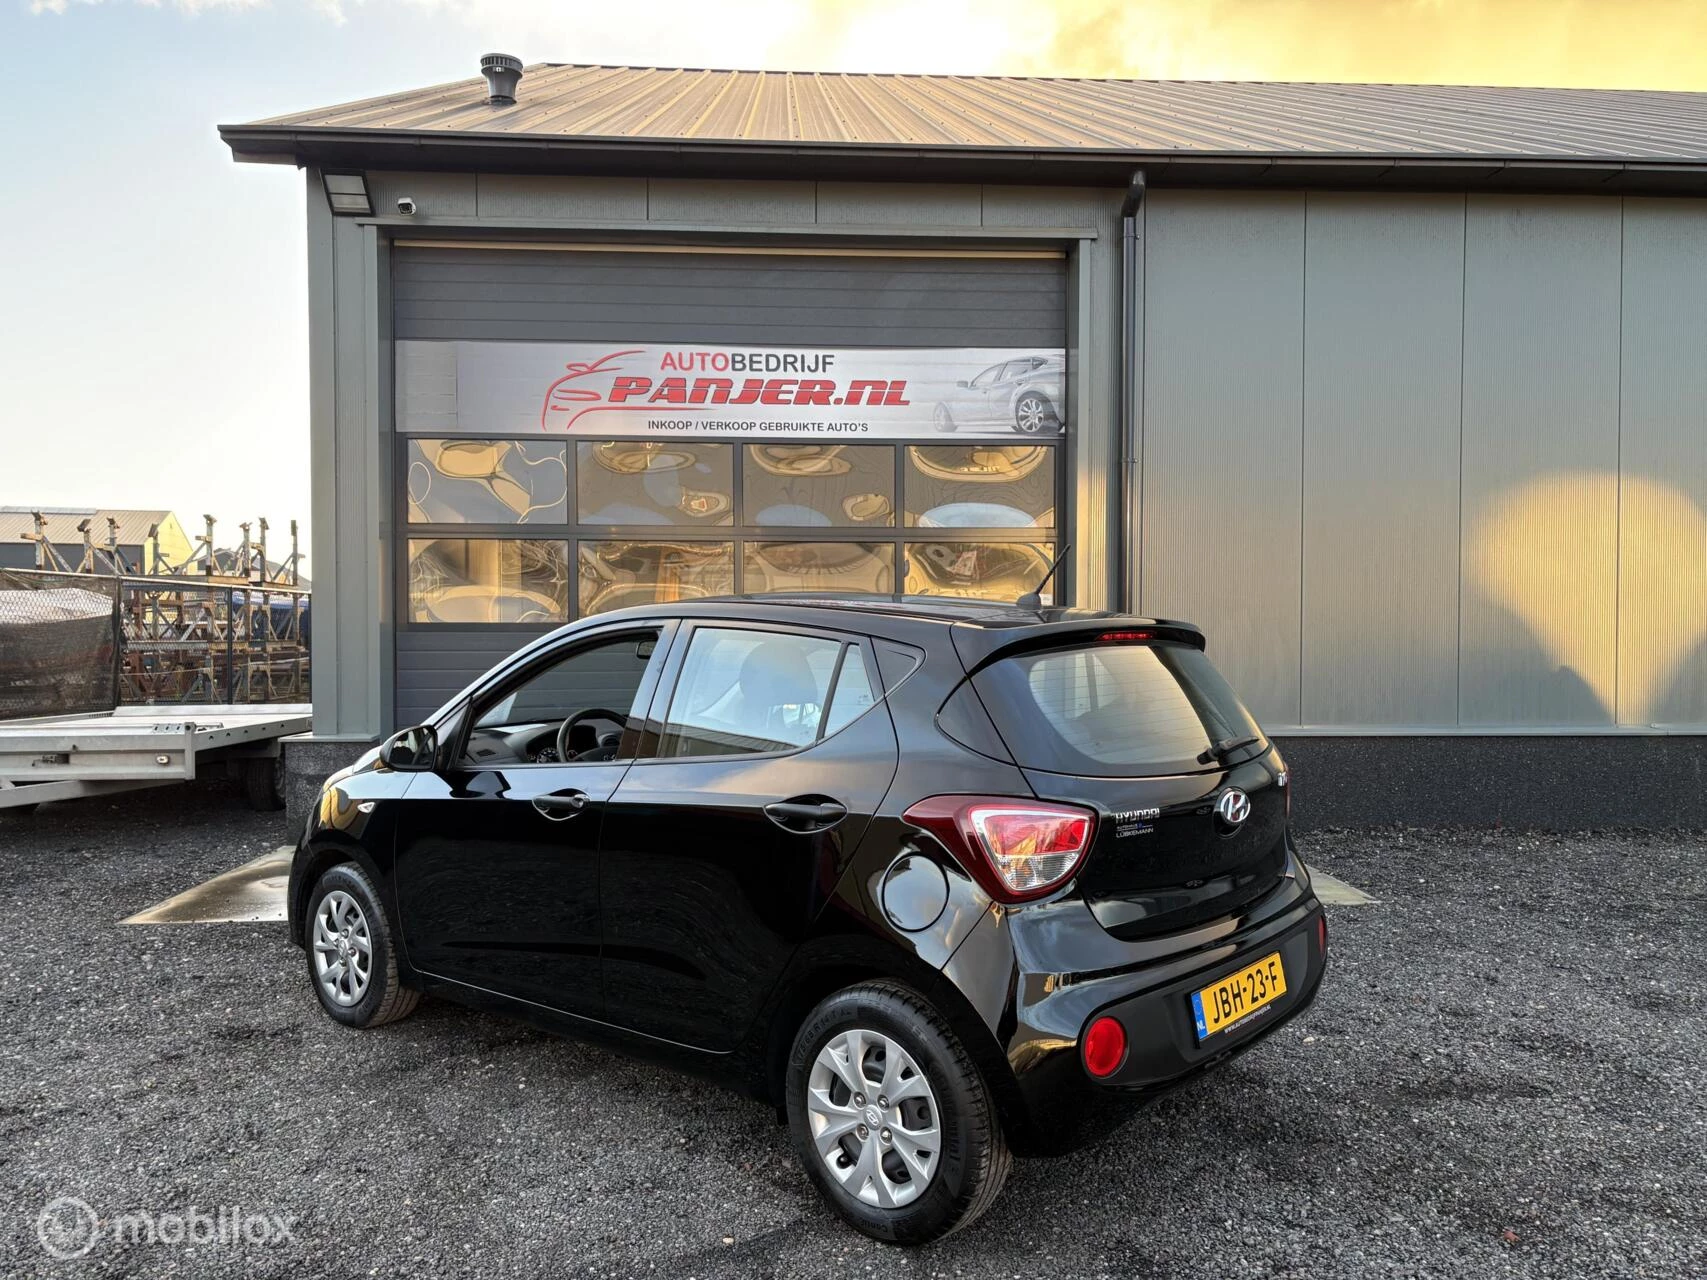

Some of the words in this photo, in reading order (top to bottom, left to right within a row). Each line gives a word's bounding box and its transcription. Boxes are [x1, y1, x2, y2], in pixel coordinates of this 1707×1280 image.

[660, 351, 835, 373] AUTOBEDRIJF
[607, 376, 911, 406] PANJER.NL
[648, 420, 692, 430] INKOOP
[701, 421, 757, 431] VERKOOP
[759, 421, 825, 432] GEBRUIKTE
[827, 422, 868, 432] AUTO'S
[1115, 807, 1160, 823] HYUNDAI
[1213, 961, 1277, 1024] JBH-23-F
